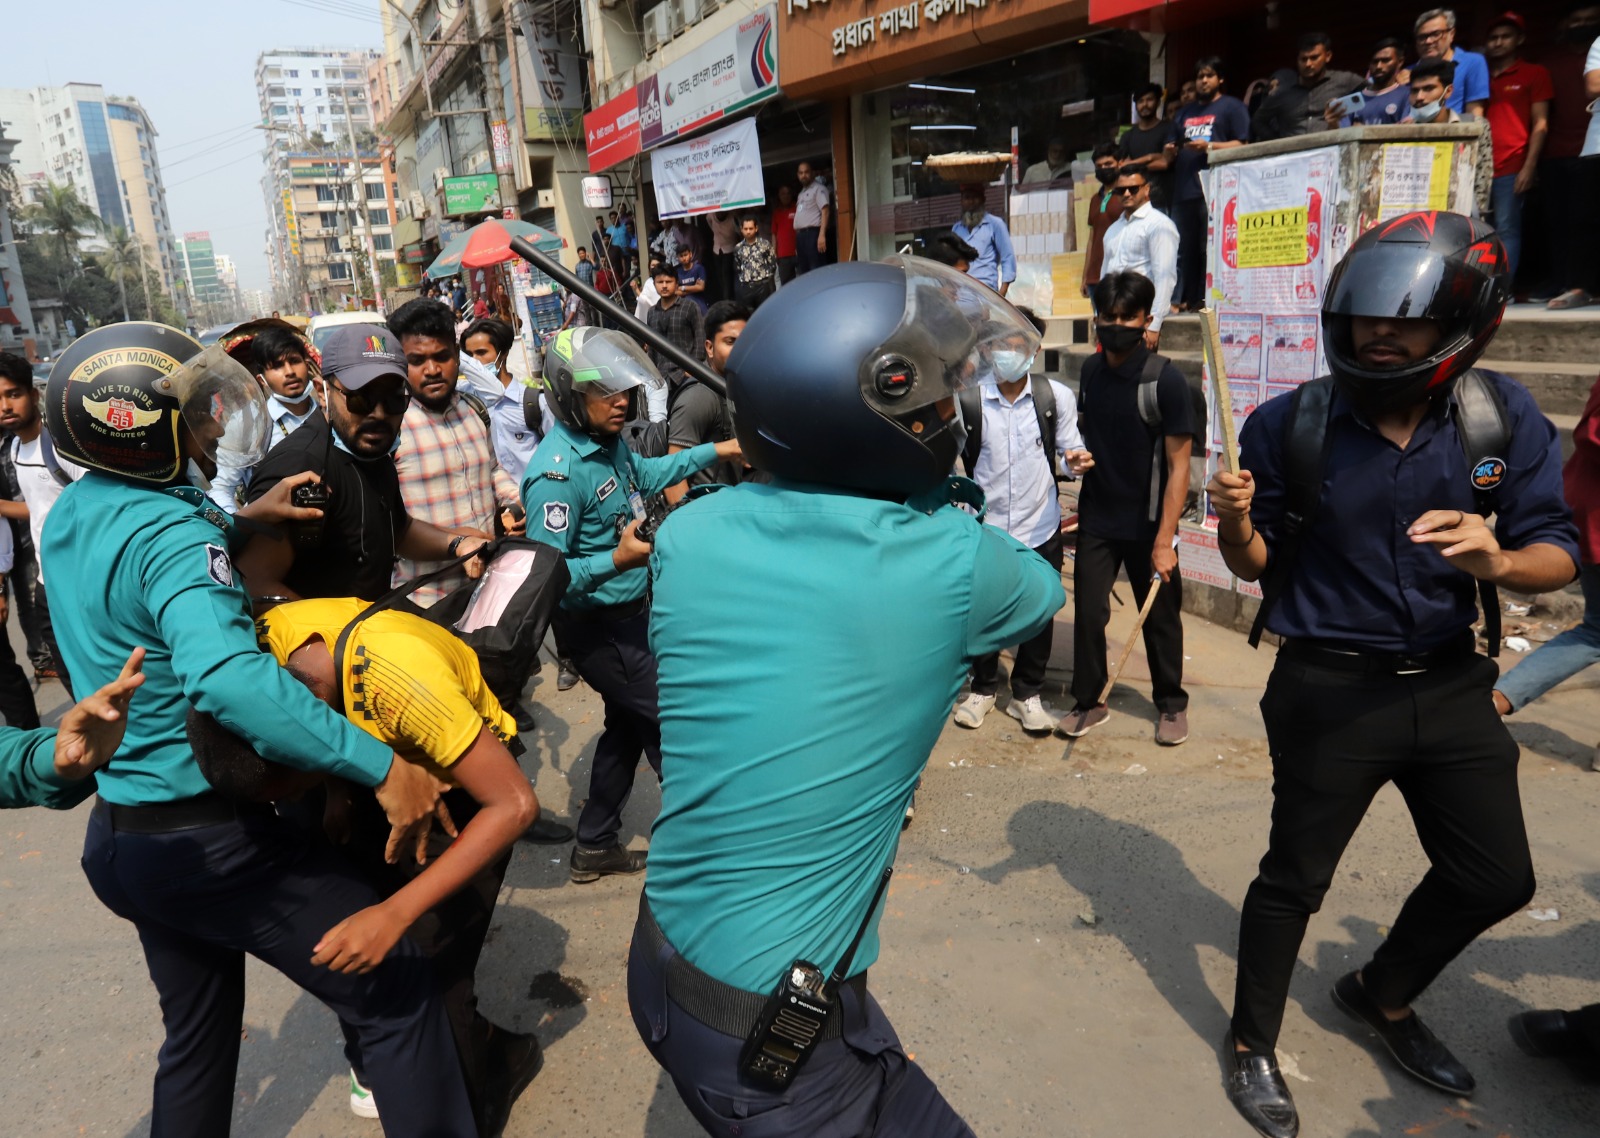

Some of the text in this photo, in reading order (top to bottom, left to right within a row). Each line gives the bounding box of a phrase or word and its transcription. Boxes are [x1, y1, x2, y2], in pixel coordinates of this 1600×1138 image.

[739, 13, 766, 33] NexusPay
[832, 15, 875, 56] প্রধান
[880, 1, 919, 35] শাখা
[692, 150, 709, 163] ব্যাংক
[711, 140, 741, 158] লিমিটেড
[1261, 168, 1288, 179] To-Let
[1242, 212, 1301, 230] TO-LET
[83, 352, 174, 376] SANTA MONICA
[92, 385, 114, 400] LIVE
[117, 385, 130, 393] TO
[90, 422, 107, 434] RIDE
[111, 415, 129, 427] 66
[798, 1001, 826, 1015] MOTOROLA
